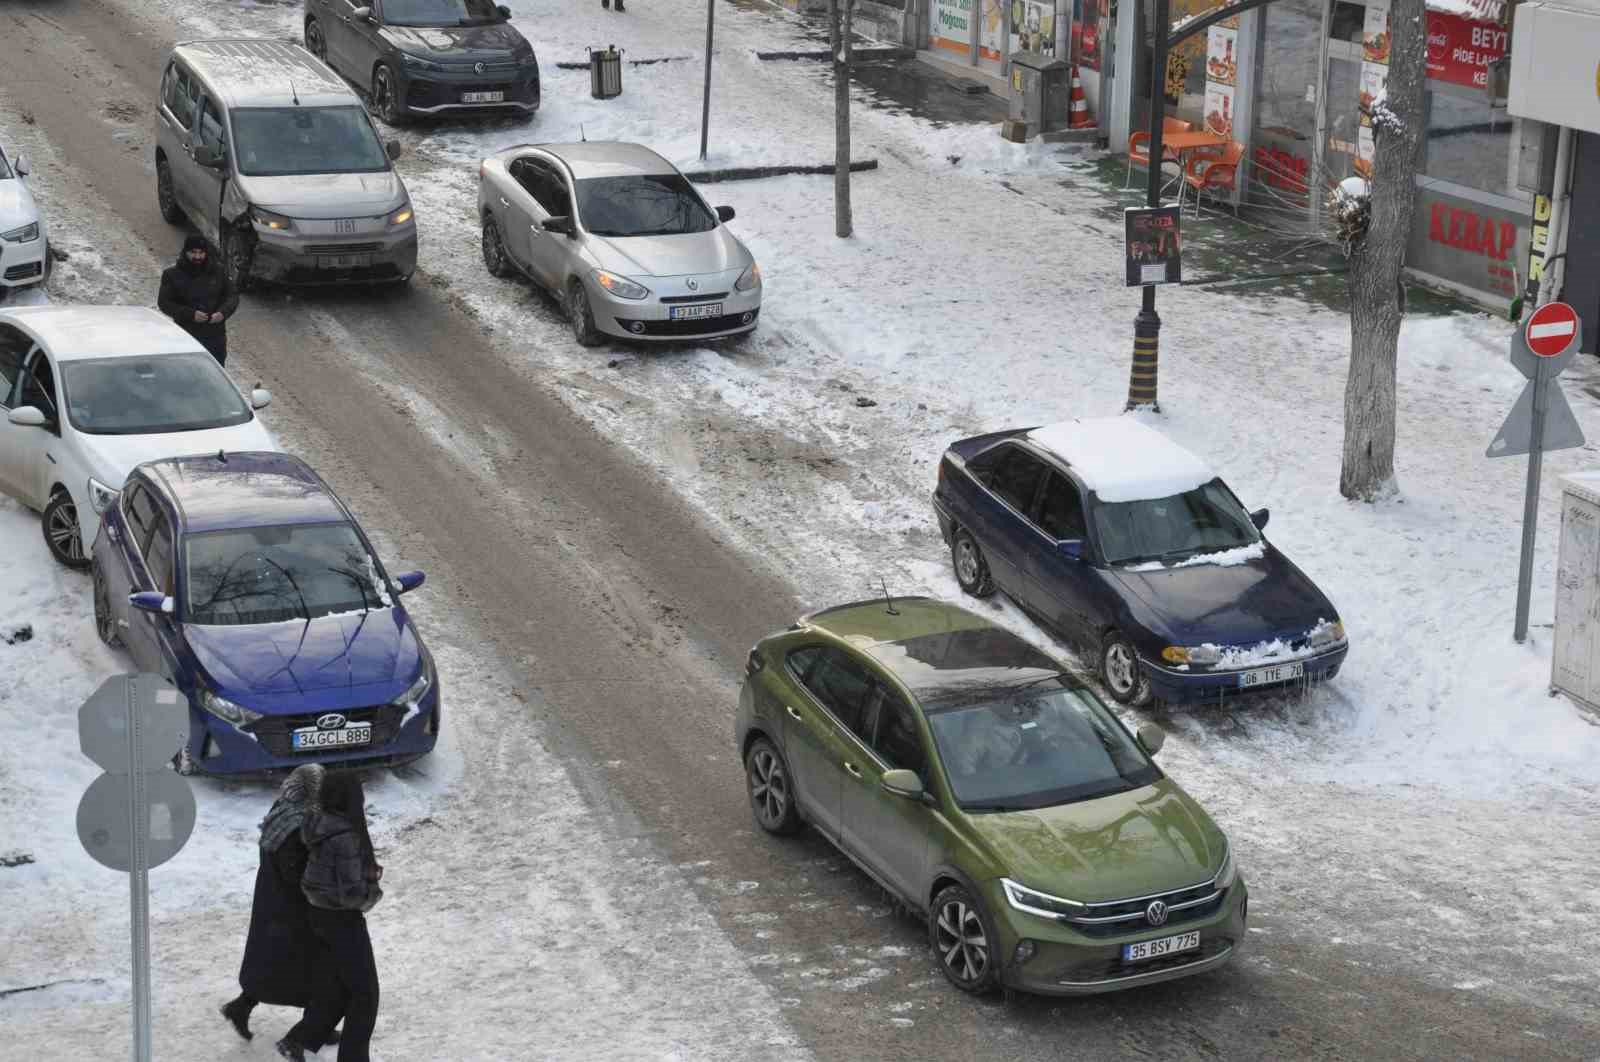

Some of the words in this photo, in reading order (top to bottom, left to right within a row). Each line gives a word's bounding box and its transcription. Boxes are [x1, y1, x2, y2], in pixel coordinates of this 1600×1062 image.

[1472, 71, 1488, 85] KE
[1429, 202, 1516, 260] KEBAP
[1245, 671, 1257, 685] 06
[1132, 945, 1146, 959] 35
[1150, 937, 1172, 955] BSV
[1177, 933, 1198, 952] 775
